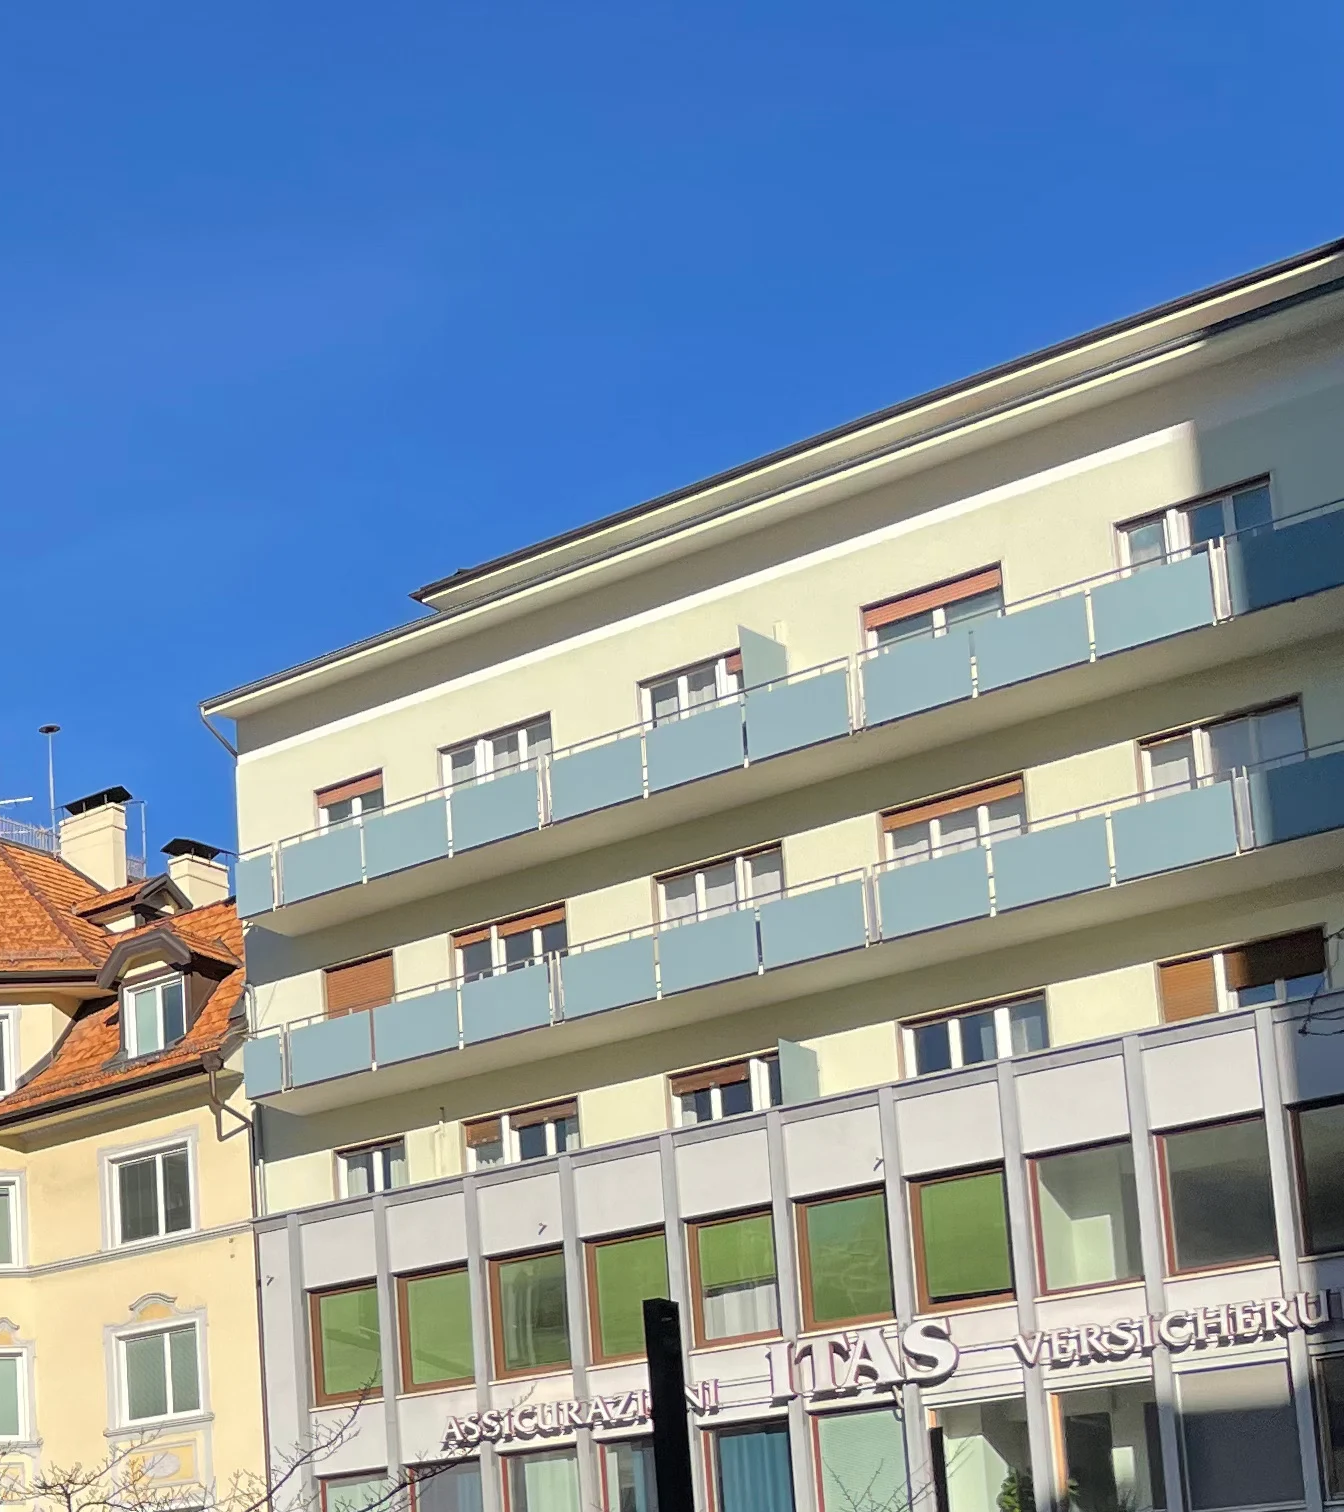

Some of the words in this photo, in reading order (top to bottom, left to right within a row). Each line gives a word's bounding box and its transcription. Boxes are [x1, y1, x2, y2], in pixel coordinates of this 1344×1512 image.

[765, 1317, 961, 1400] ITAS
[1013, 1286, 1344, 1367] VERSICHERU
[441, 1378, 720, 1444] ASSICURAZINI
